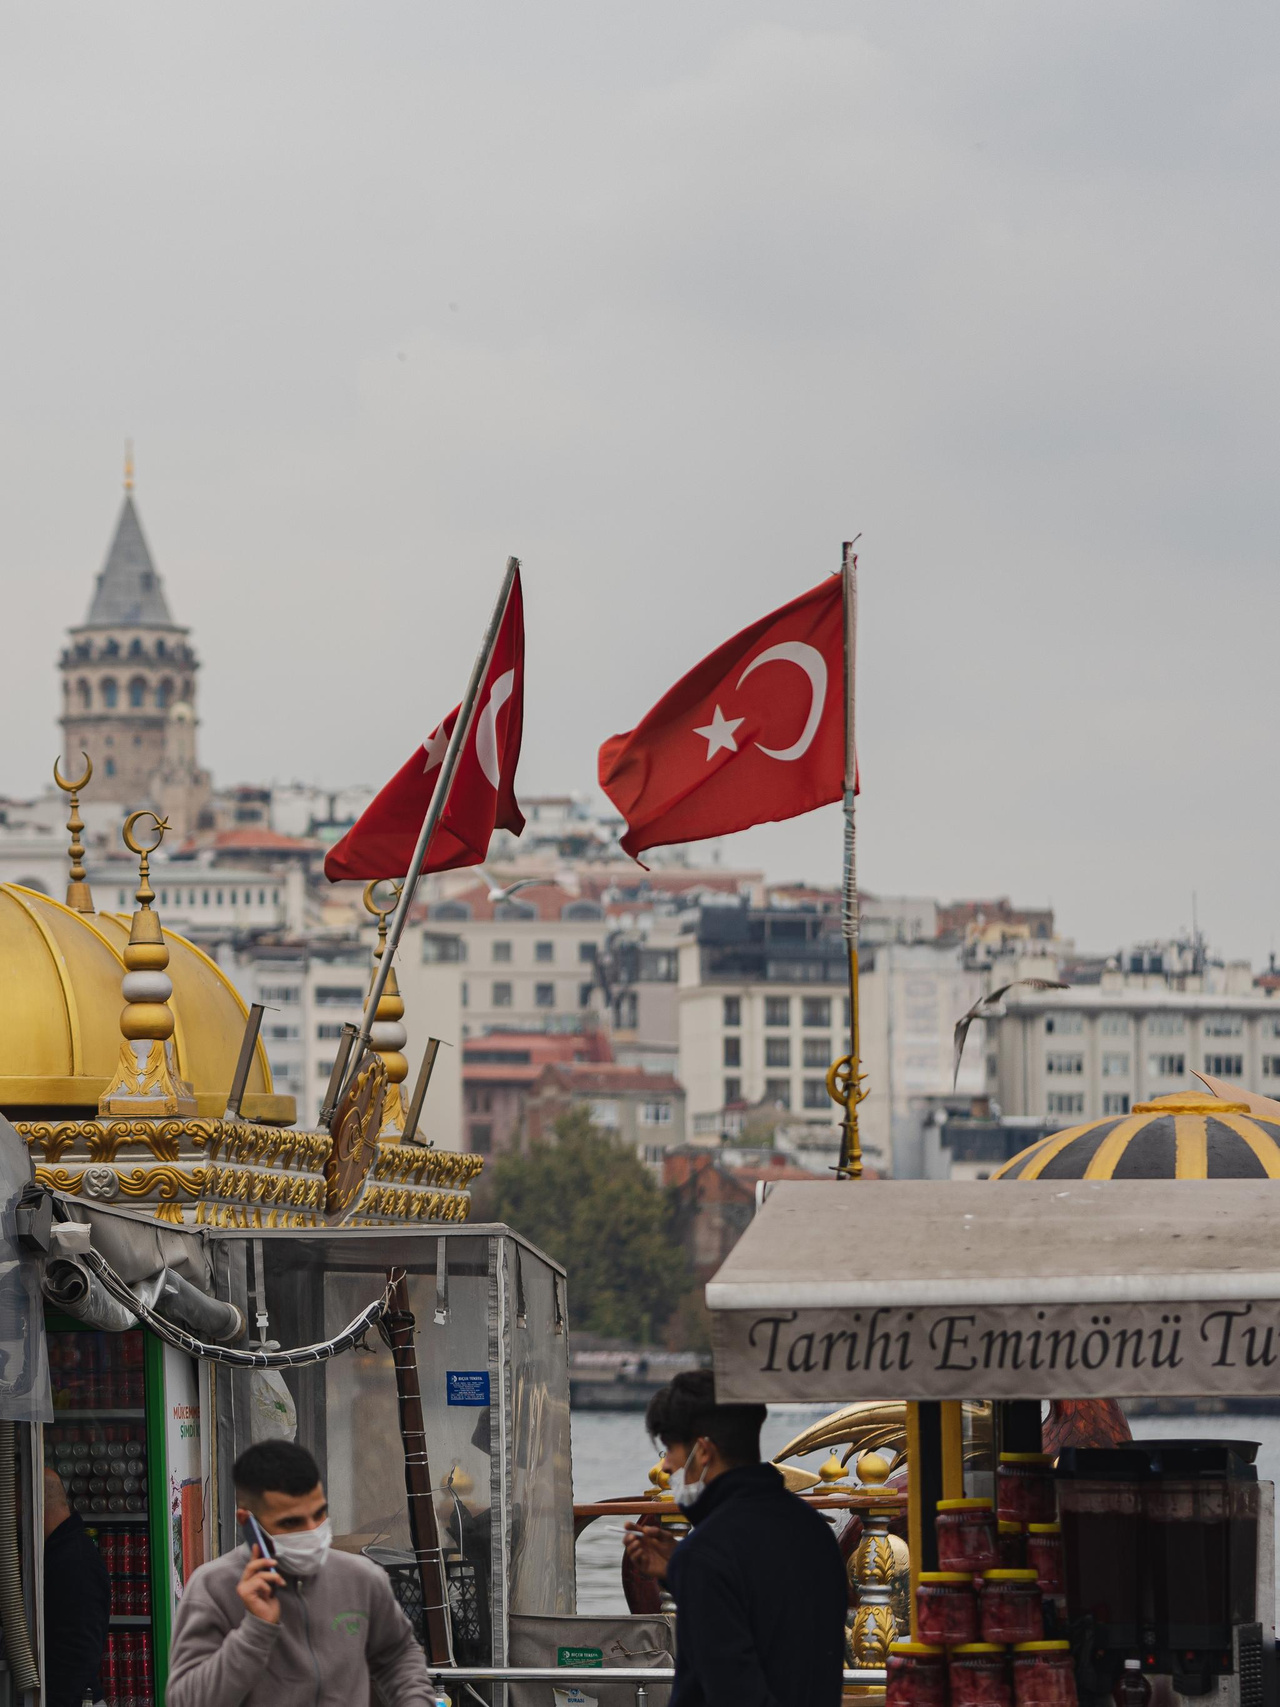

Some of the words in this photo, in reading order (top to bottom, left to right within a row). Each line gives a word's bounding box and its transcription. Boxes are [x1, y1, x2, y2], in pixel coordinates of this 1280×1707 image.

[749, 1308, 915, 1373] Tarihi
[928, 1310, 1183, 1373] Eminönü
[1200, 1303, 1280, 1368] Tu
